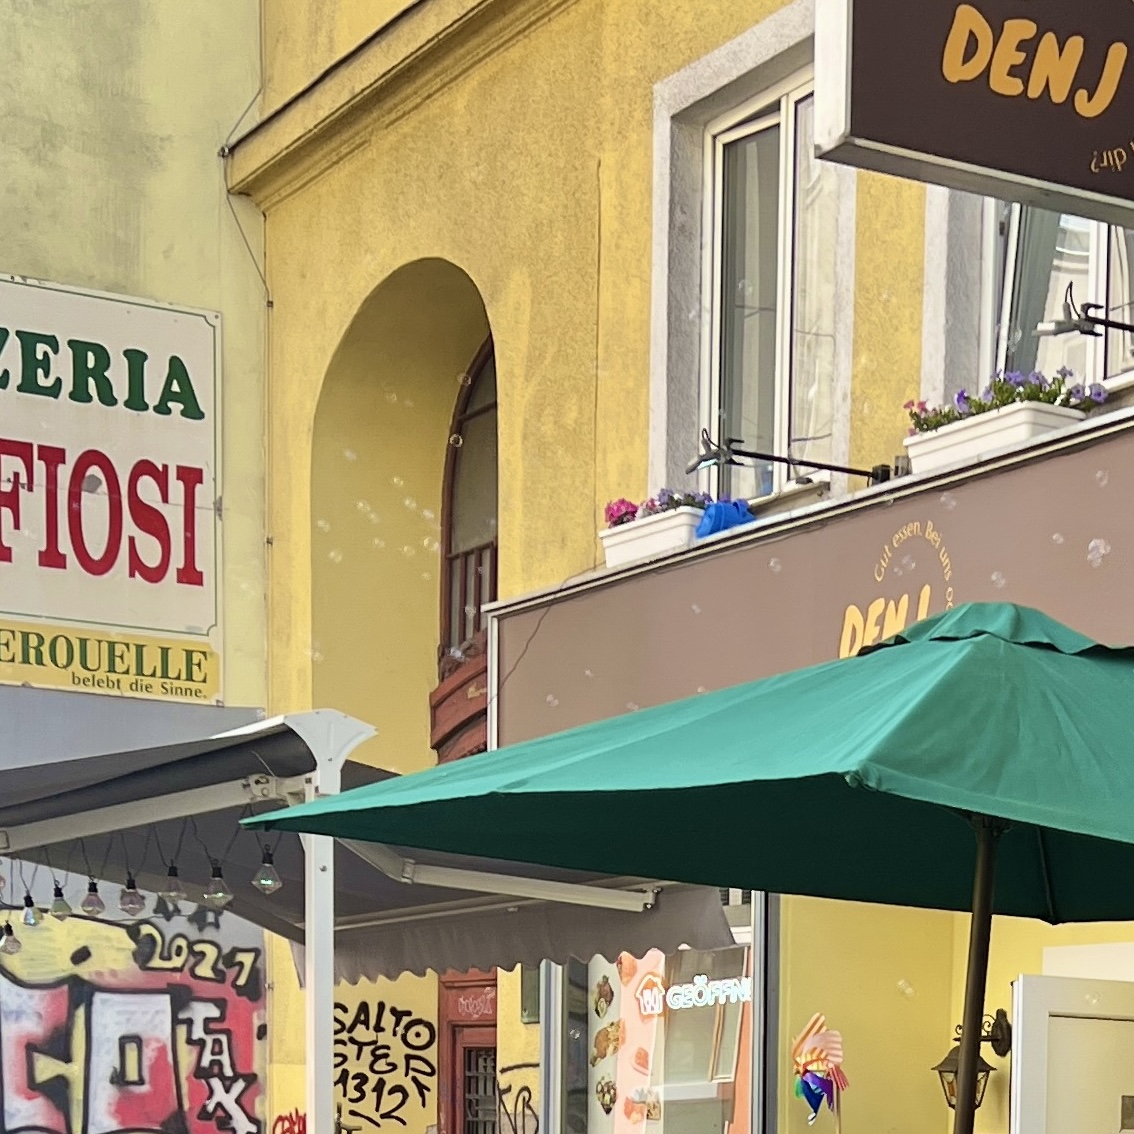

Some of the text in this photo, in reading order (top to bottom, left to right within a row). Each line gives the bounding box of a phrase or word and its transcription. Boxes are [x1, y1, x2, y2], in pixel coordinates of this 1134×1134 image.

[942, 4, 1128, 118] DENJ
[0, 327, 205, 421] ERIA
[874, 545, 893, 582] Gut
[939, 546, 953, 581] uns
[71, 672, 208, 699] belebt die Sinne.
